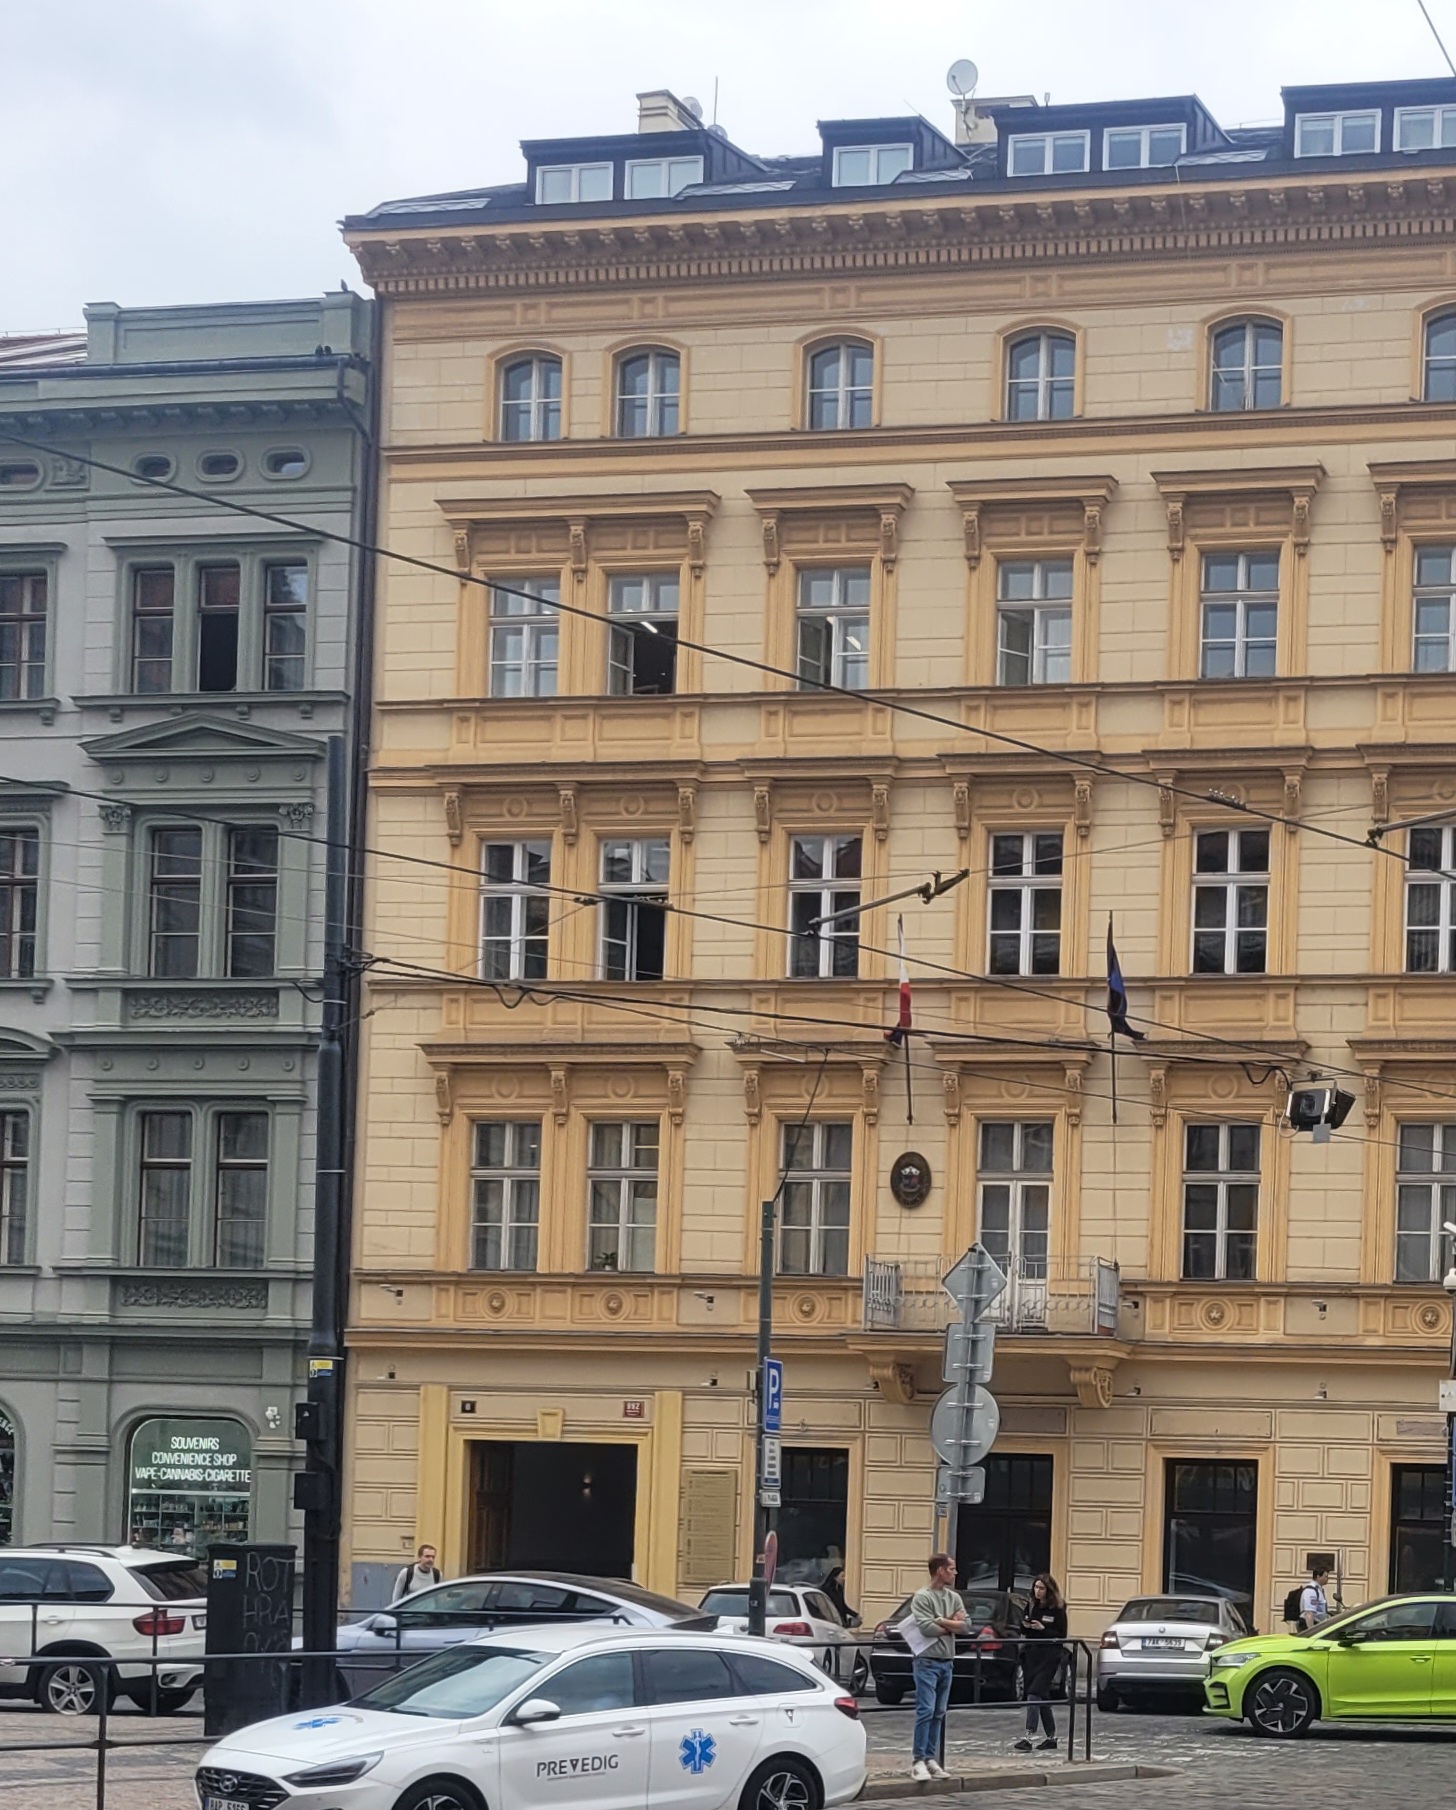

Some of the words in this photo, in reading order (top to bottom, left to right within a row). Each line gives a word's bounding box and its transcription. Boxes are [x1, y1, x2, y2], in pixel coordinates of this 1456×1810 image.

[768, 1368, 779, 1410] P
[170, 1436, 220, 1450] SOUVENIRS
[151, 1451, 213, 1466] CONVENIENCE
[213, 1453, 238, 1467] SHOP
[134, 1466, 252, 1483] VAPE-CANNABIS-CIGARETTE
[536, 1754, 619, 1778] PREVEDIG
